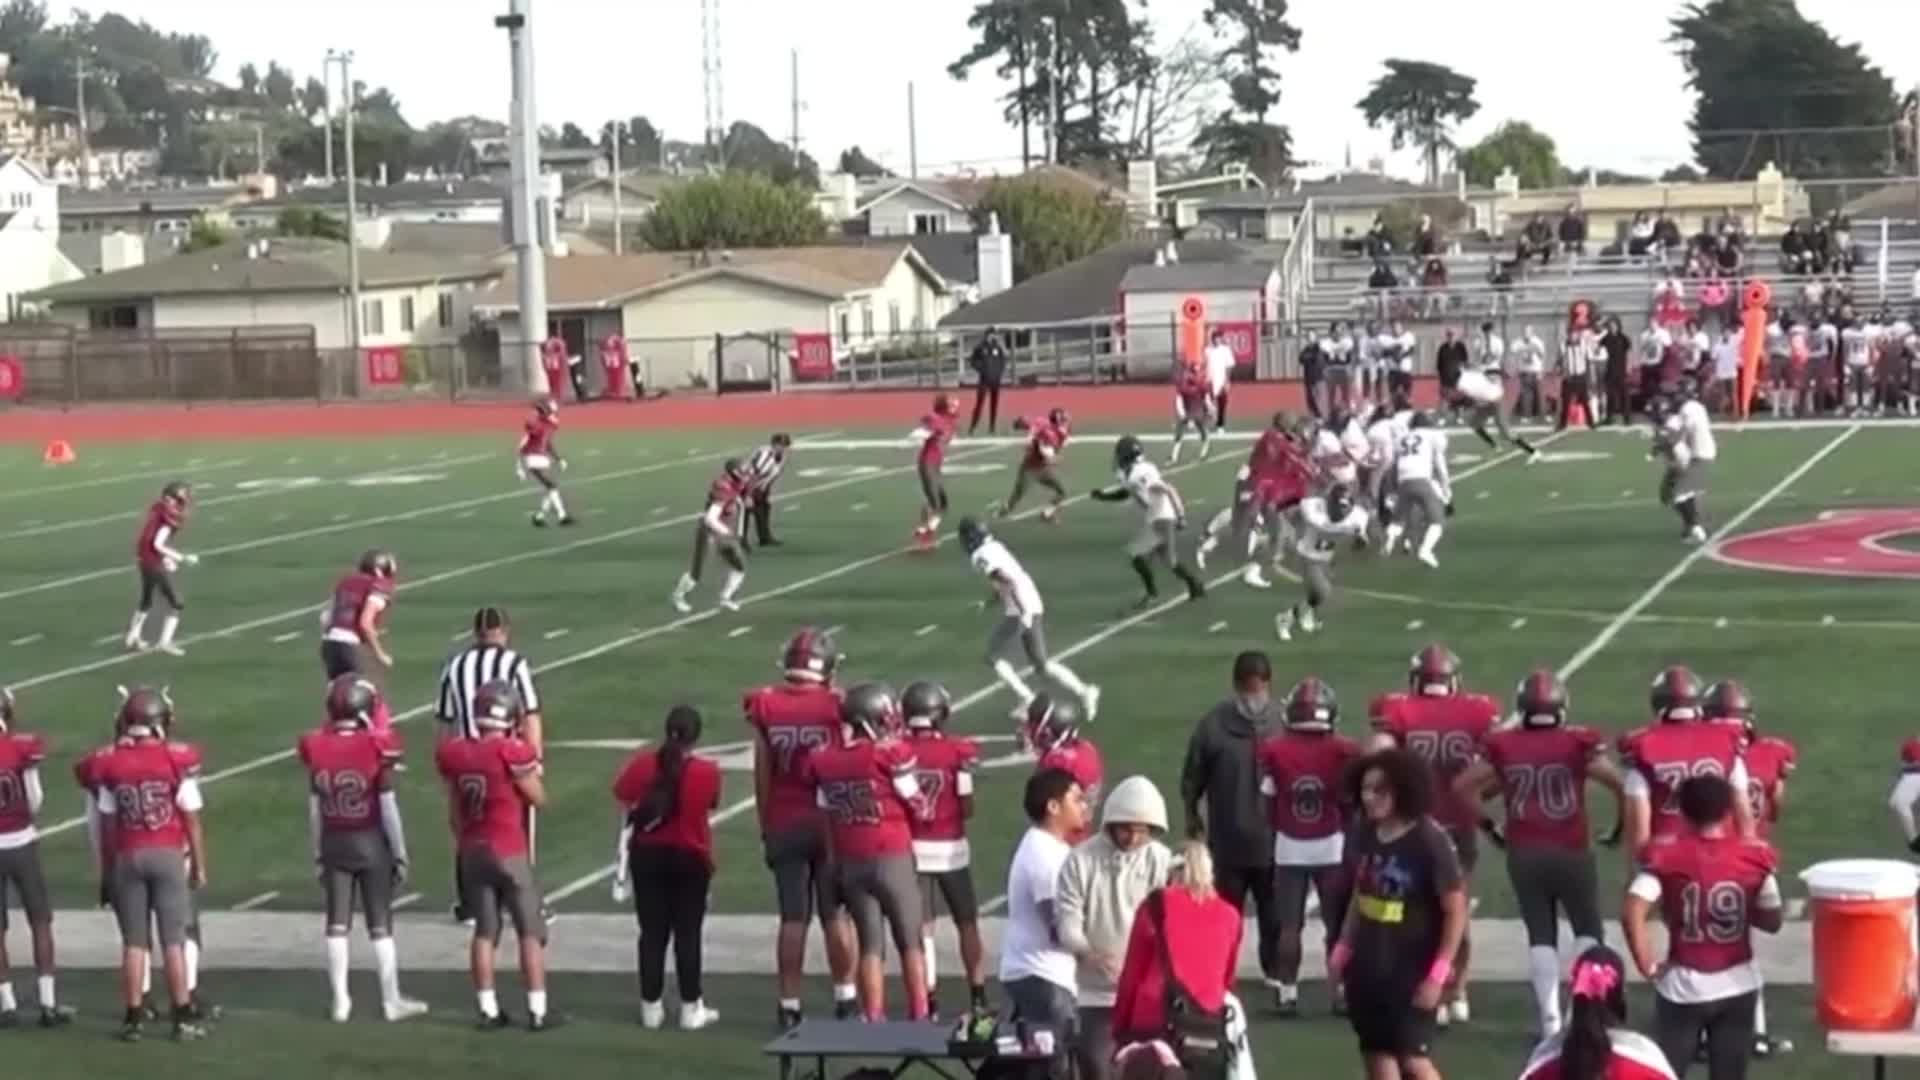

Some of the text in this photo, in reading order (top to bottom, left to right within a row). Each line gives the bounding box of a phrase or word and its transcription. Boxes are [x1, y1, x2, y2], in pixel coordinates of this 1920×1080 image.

[314, 768, 369, 819] 12
[458, 773, 488, 820] 7
[912, 767, 944, 820] 7
[1505, 763, 1578, 820] 70
[1680, 880, 1746, 942] 19
